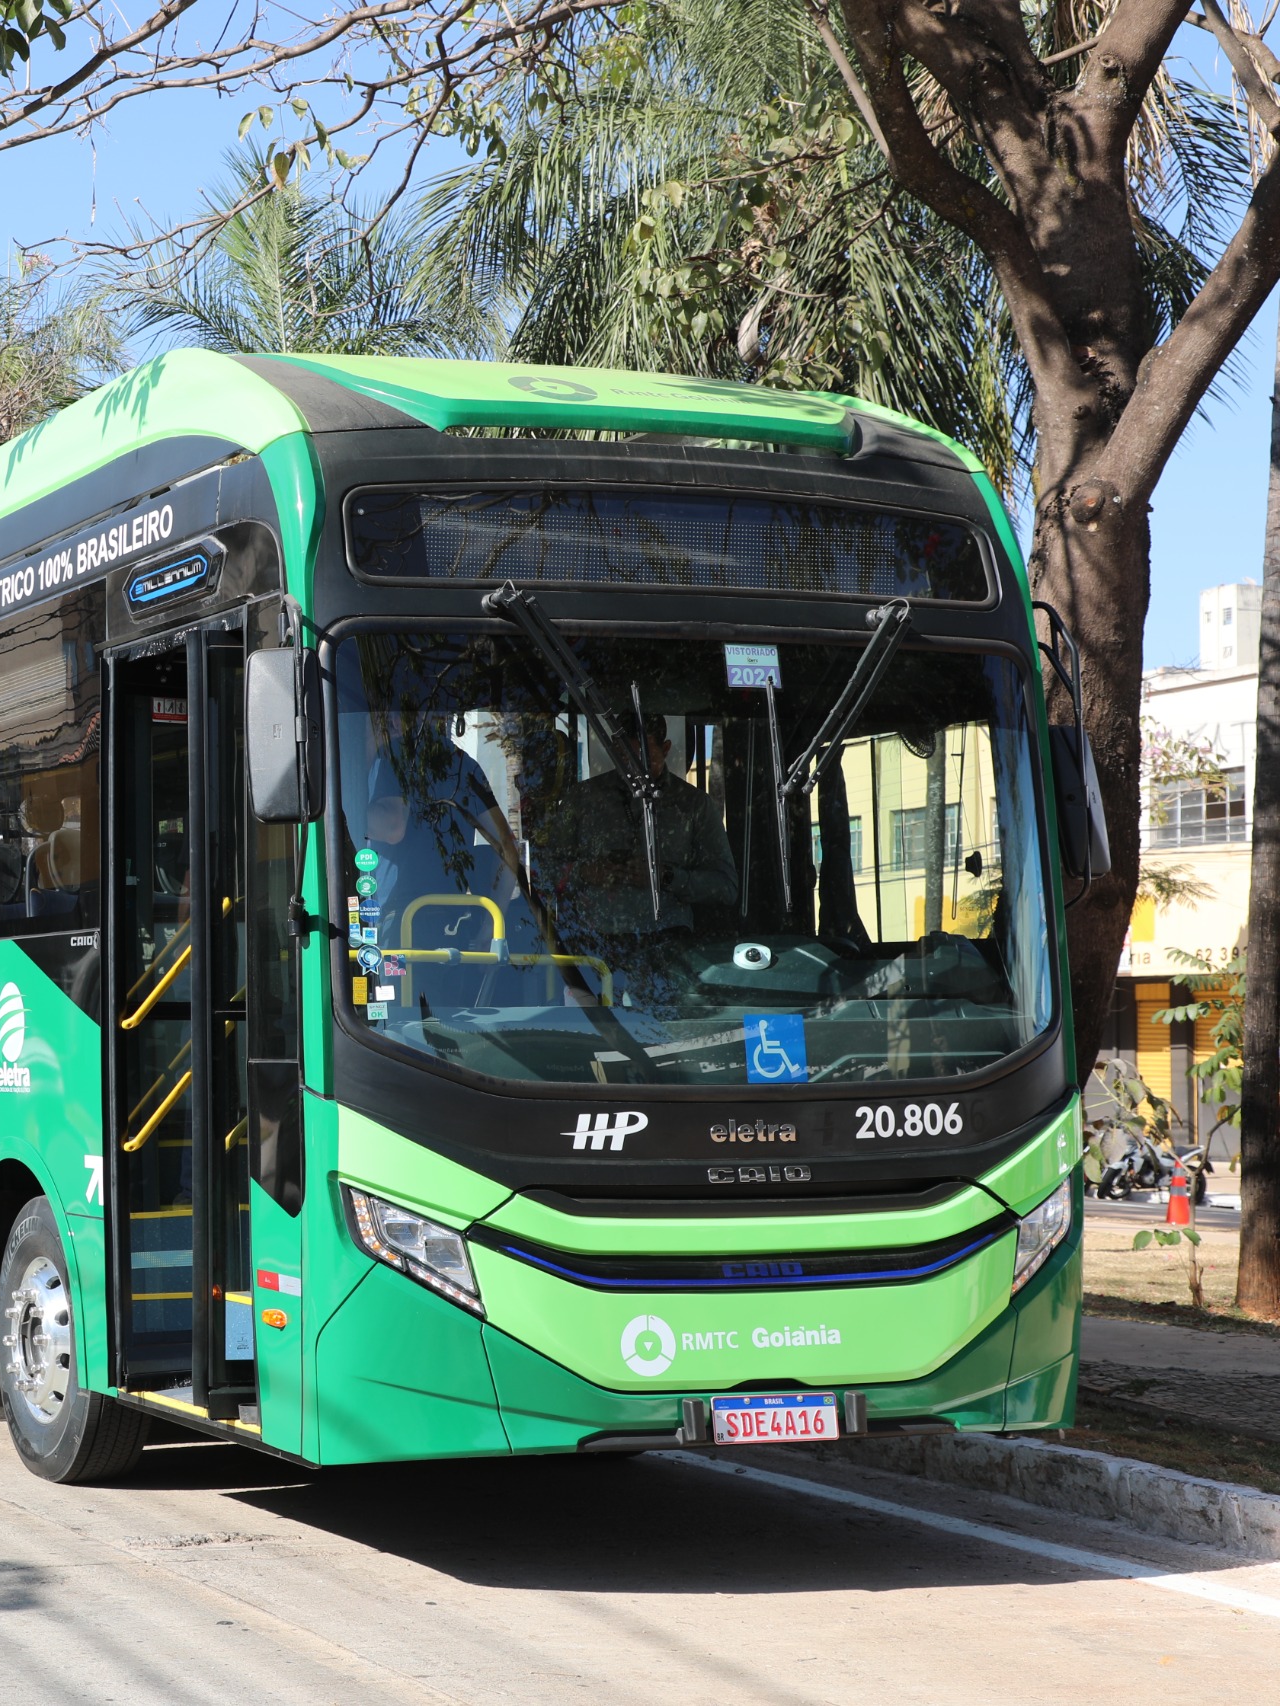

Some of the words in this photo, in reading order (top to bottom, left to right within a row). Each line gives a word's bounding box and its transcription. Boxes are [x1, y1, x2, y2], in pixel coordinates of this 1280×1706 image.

[38, 548, 73, 590] 100%
[76, 504, 174, 575] BRASILEIRO
[726, 647, 777, 657] VISTORIADO
[731, 667, 778, 686] 2024
[70, 935, 93, 947] CAIO
[855, 1102, 963, 1139] 20.806
[710, 1118, 797, 1143] eletra
[707, 1165, 813, 1184] CAIO
[721, 1262, 804, 1278] CAIO
[681, 1331, 739, 1351] RMTC
[726, 1409, 825, 1438] SDE4A16
